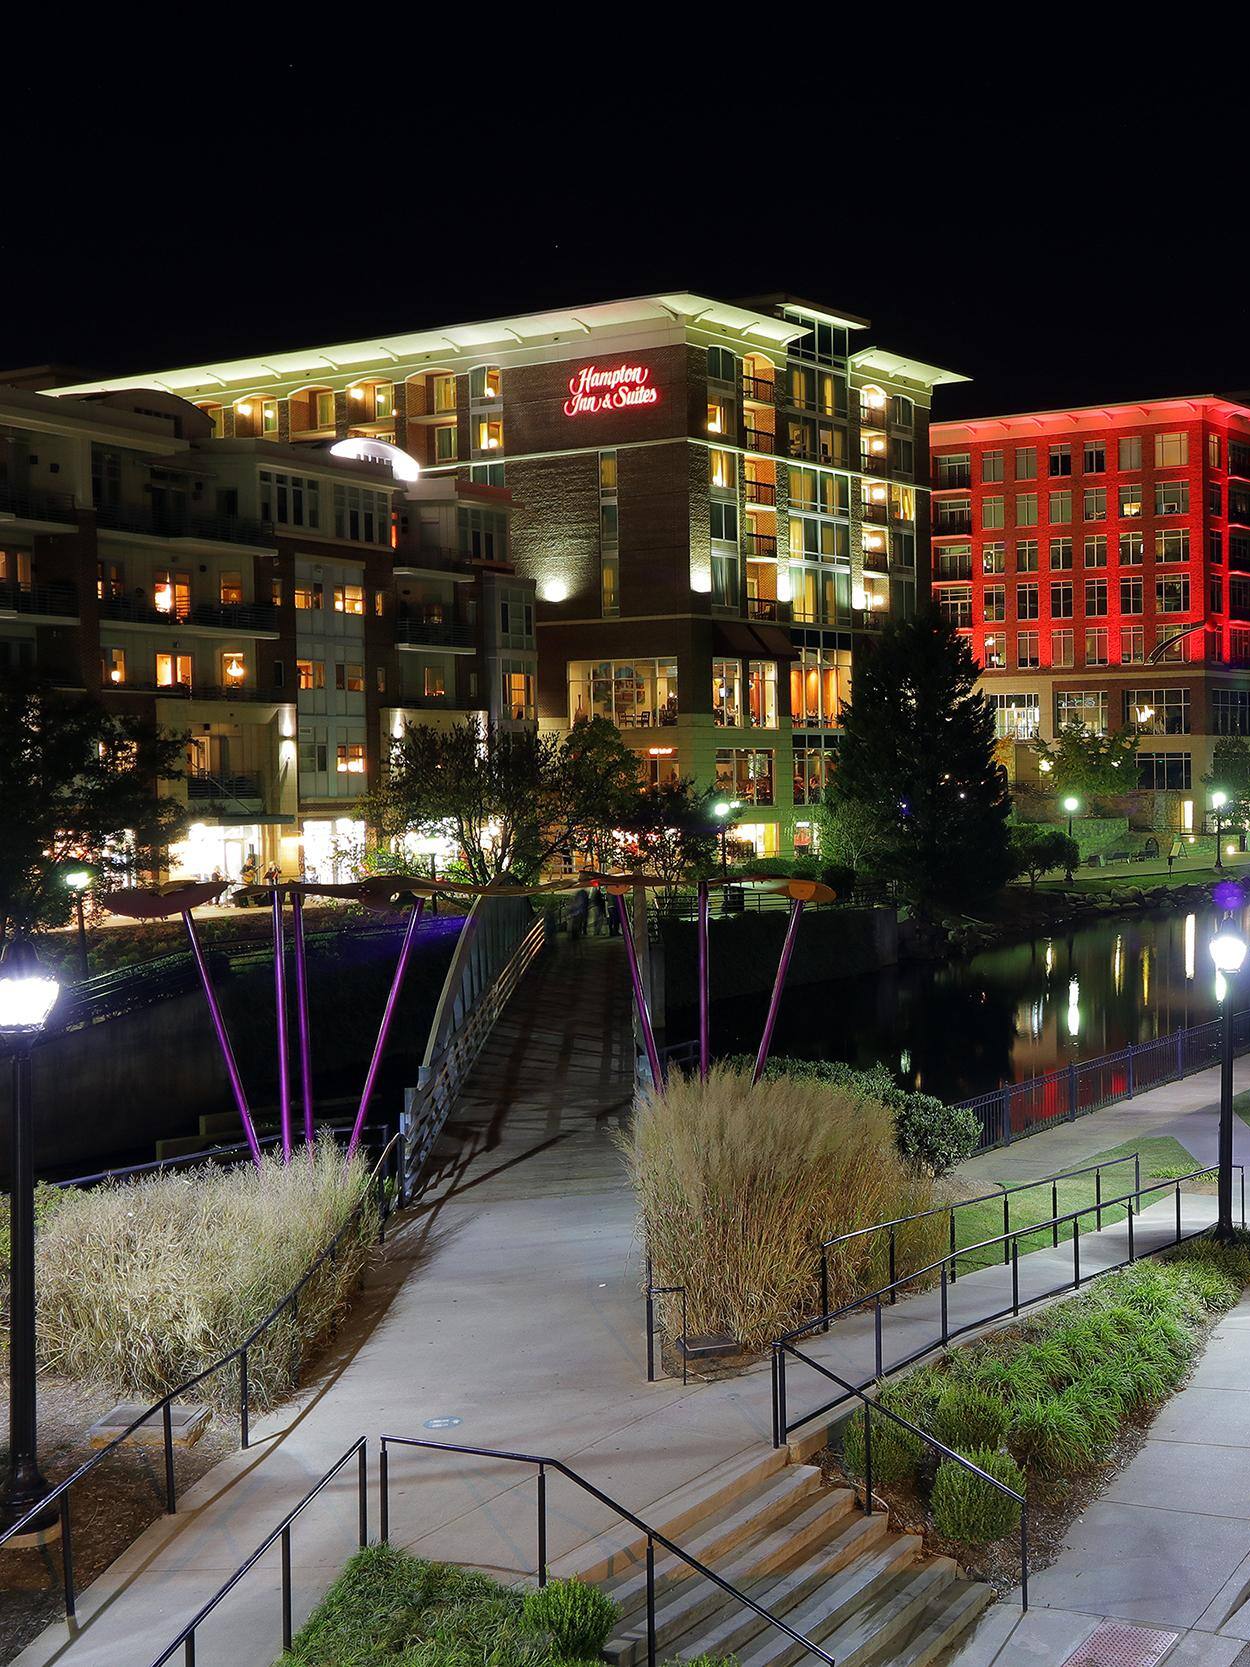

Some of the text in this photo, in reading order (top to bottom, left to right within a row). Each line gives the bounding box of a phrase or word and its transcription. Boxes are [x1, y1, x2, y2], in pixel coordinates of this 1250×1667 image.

[569, 365, 649, 395] Hampton
[564, 385, 657, 416] Inn & Suites
